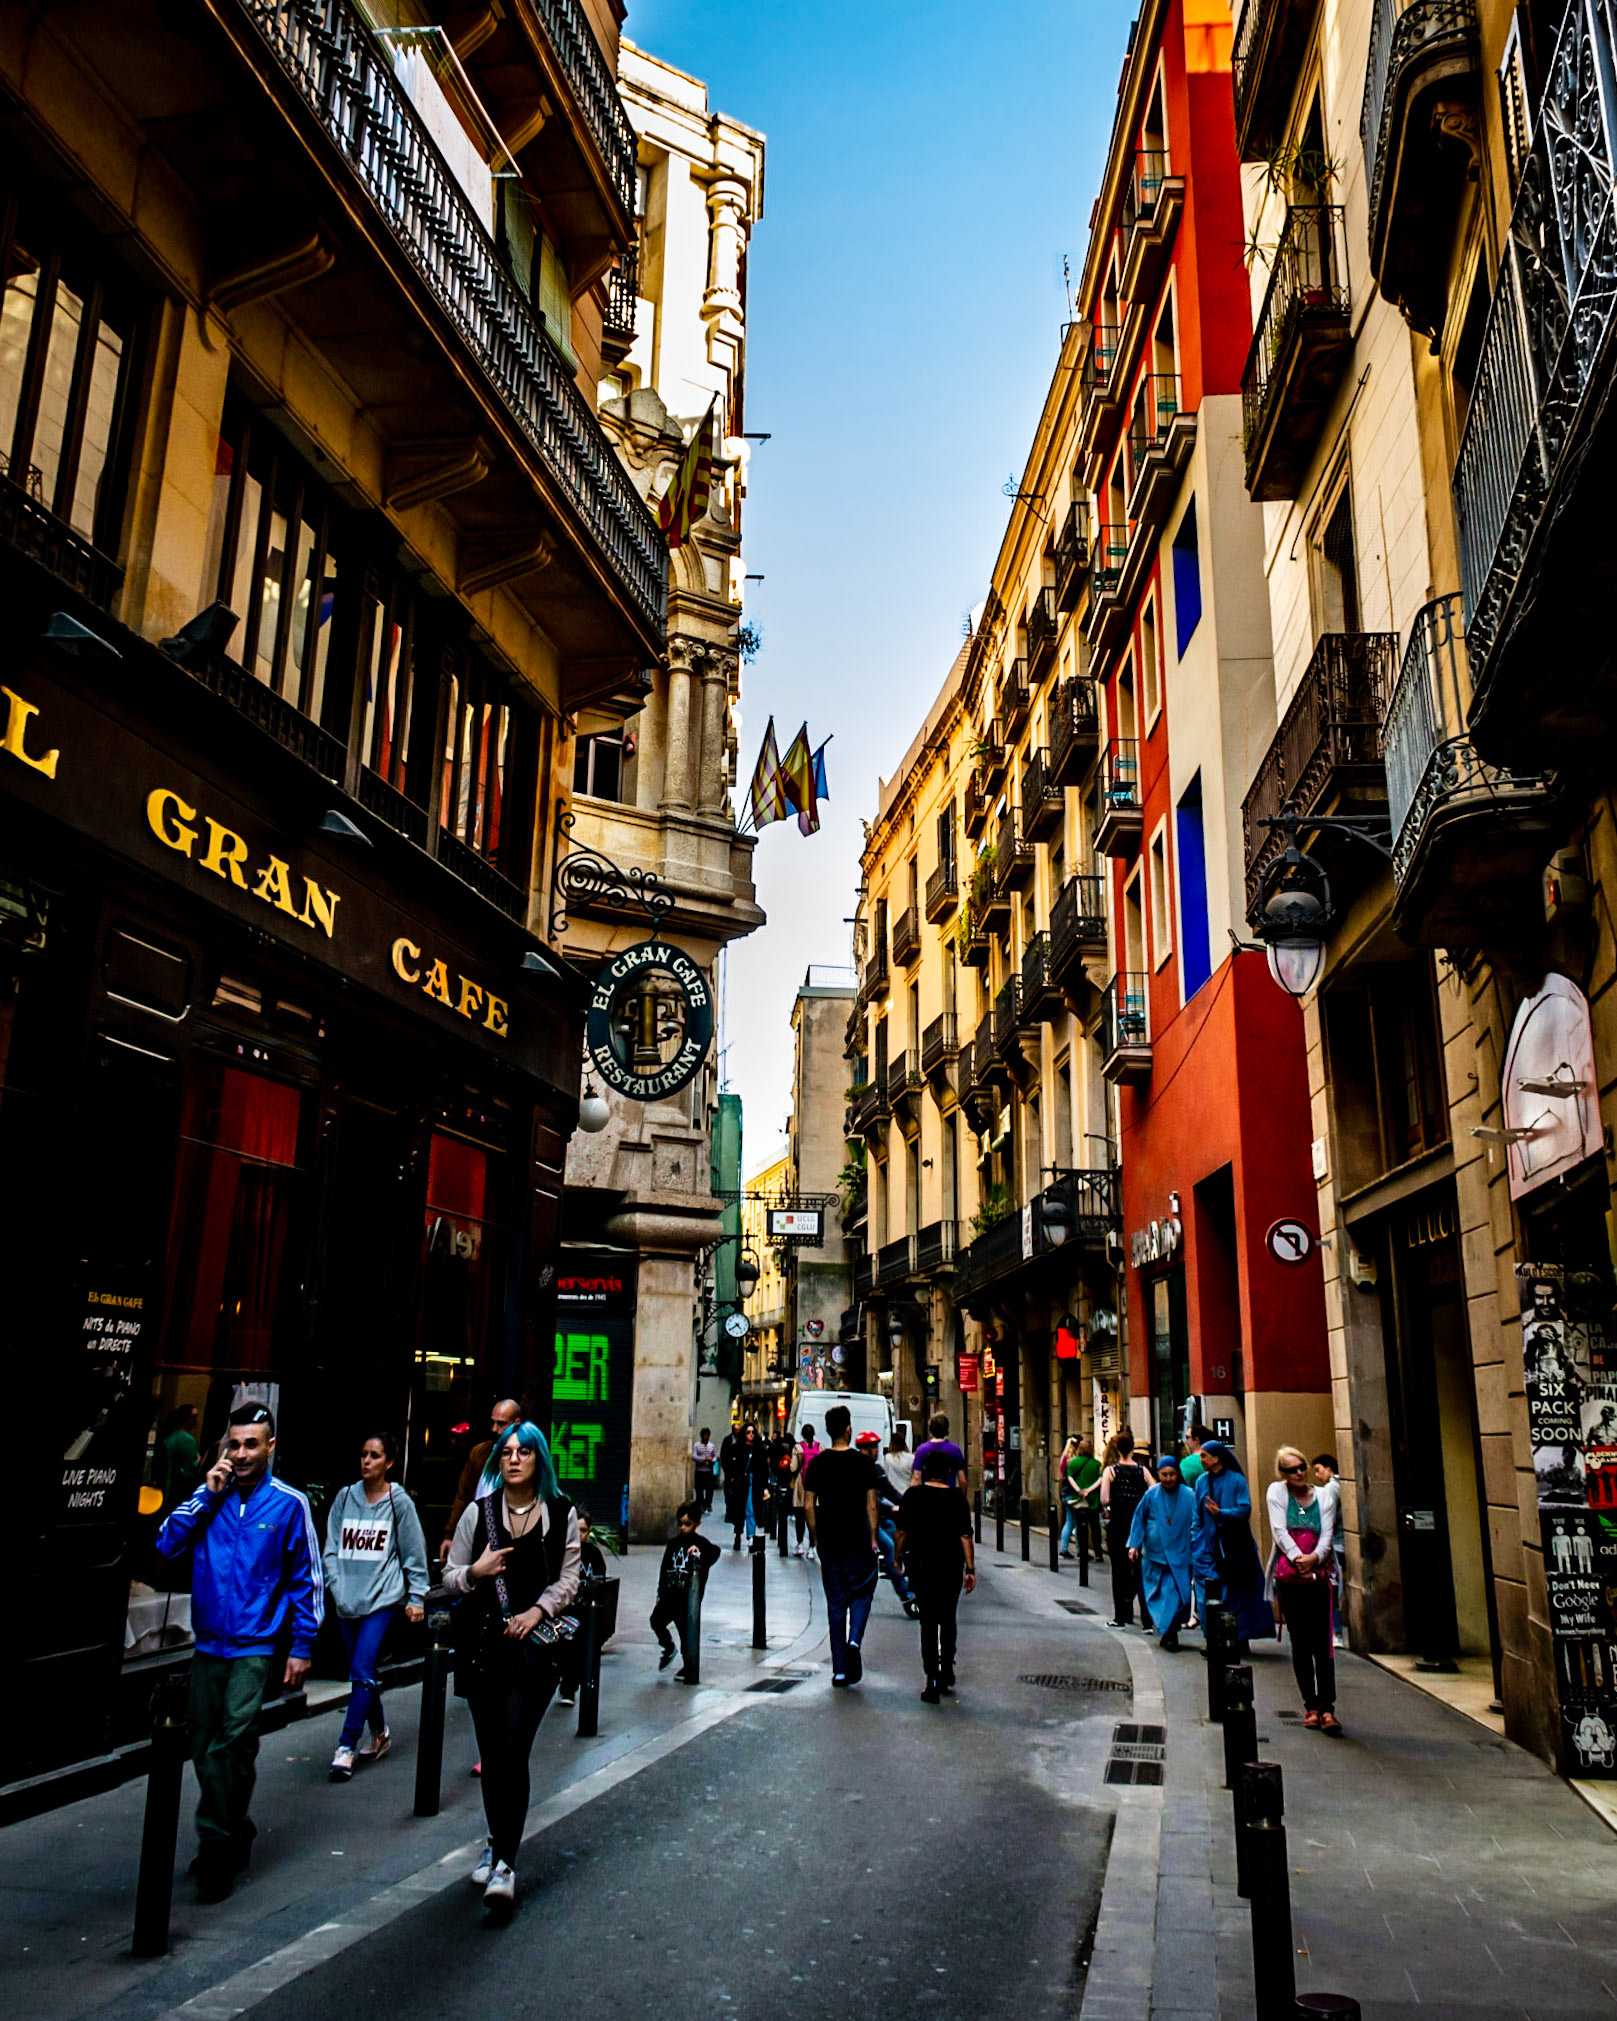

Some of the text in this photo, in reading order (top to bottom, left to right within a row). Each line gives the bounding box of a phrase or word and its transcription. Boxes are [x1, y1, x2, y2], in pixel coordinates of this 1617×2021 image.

[146, 788, 341, 939] GRAN
[391, 937, 510, 1038] CAFE
[592, 946, 706, 1010] EL GRAN CAFE
[594, 1037, 701, 1095] RESTAURANT
[82, 1317, 104, 1332] NITS
[115, 1320, 141, 1336] PIANO
[1589, 1323, 1603, 1333] LA
[98, 1337, 132, 1353] DIRECTE
[1539, 1383, 1566, 1396] SIX
[1531, 1401, 1576, 1415] PACK
[1217, 1420, 1230, 1437] H
[1537, 1417, 1573, 1425] COMING
[1531, 1427, 1582, 1441] SOON
[61, 1467, 117, 1486] LIVE PIANO
[67, 1490, 106, 1509] NIGHTS
[343, 1528, 387, 1551] WOKE
[1552, 1580, 1576, 1591] Don't
[1553, 1591, 1598, 1612] Google
[1560, 1612, 1596, 1626] My Wife
